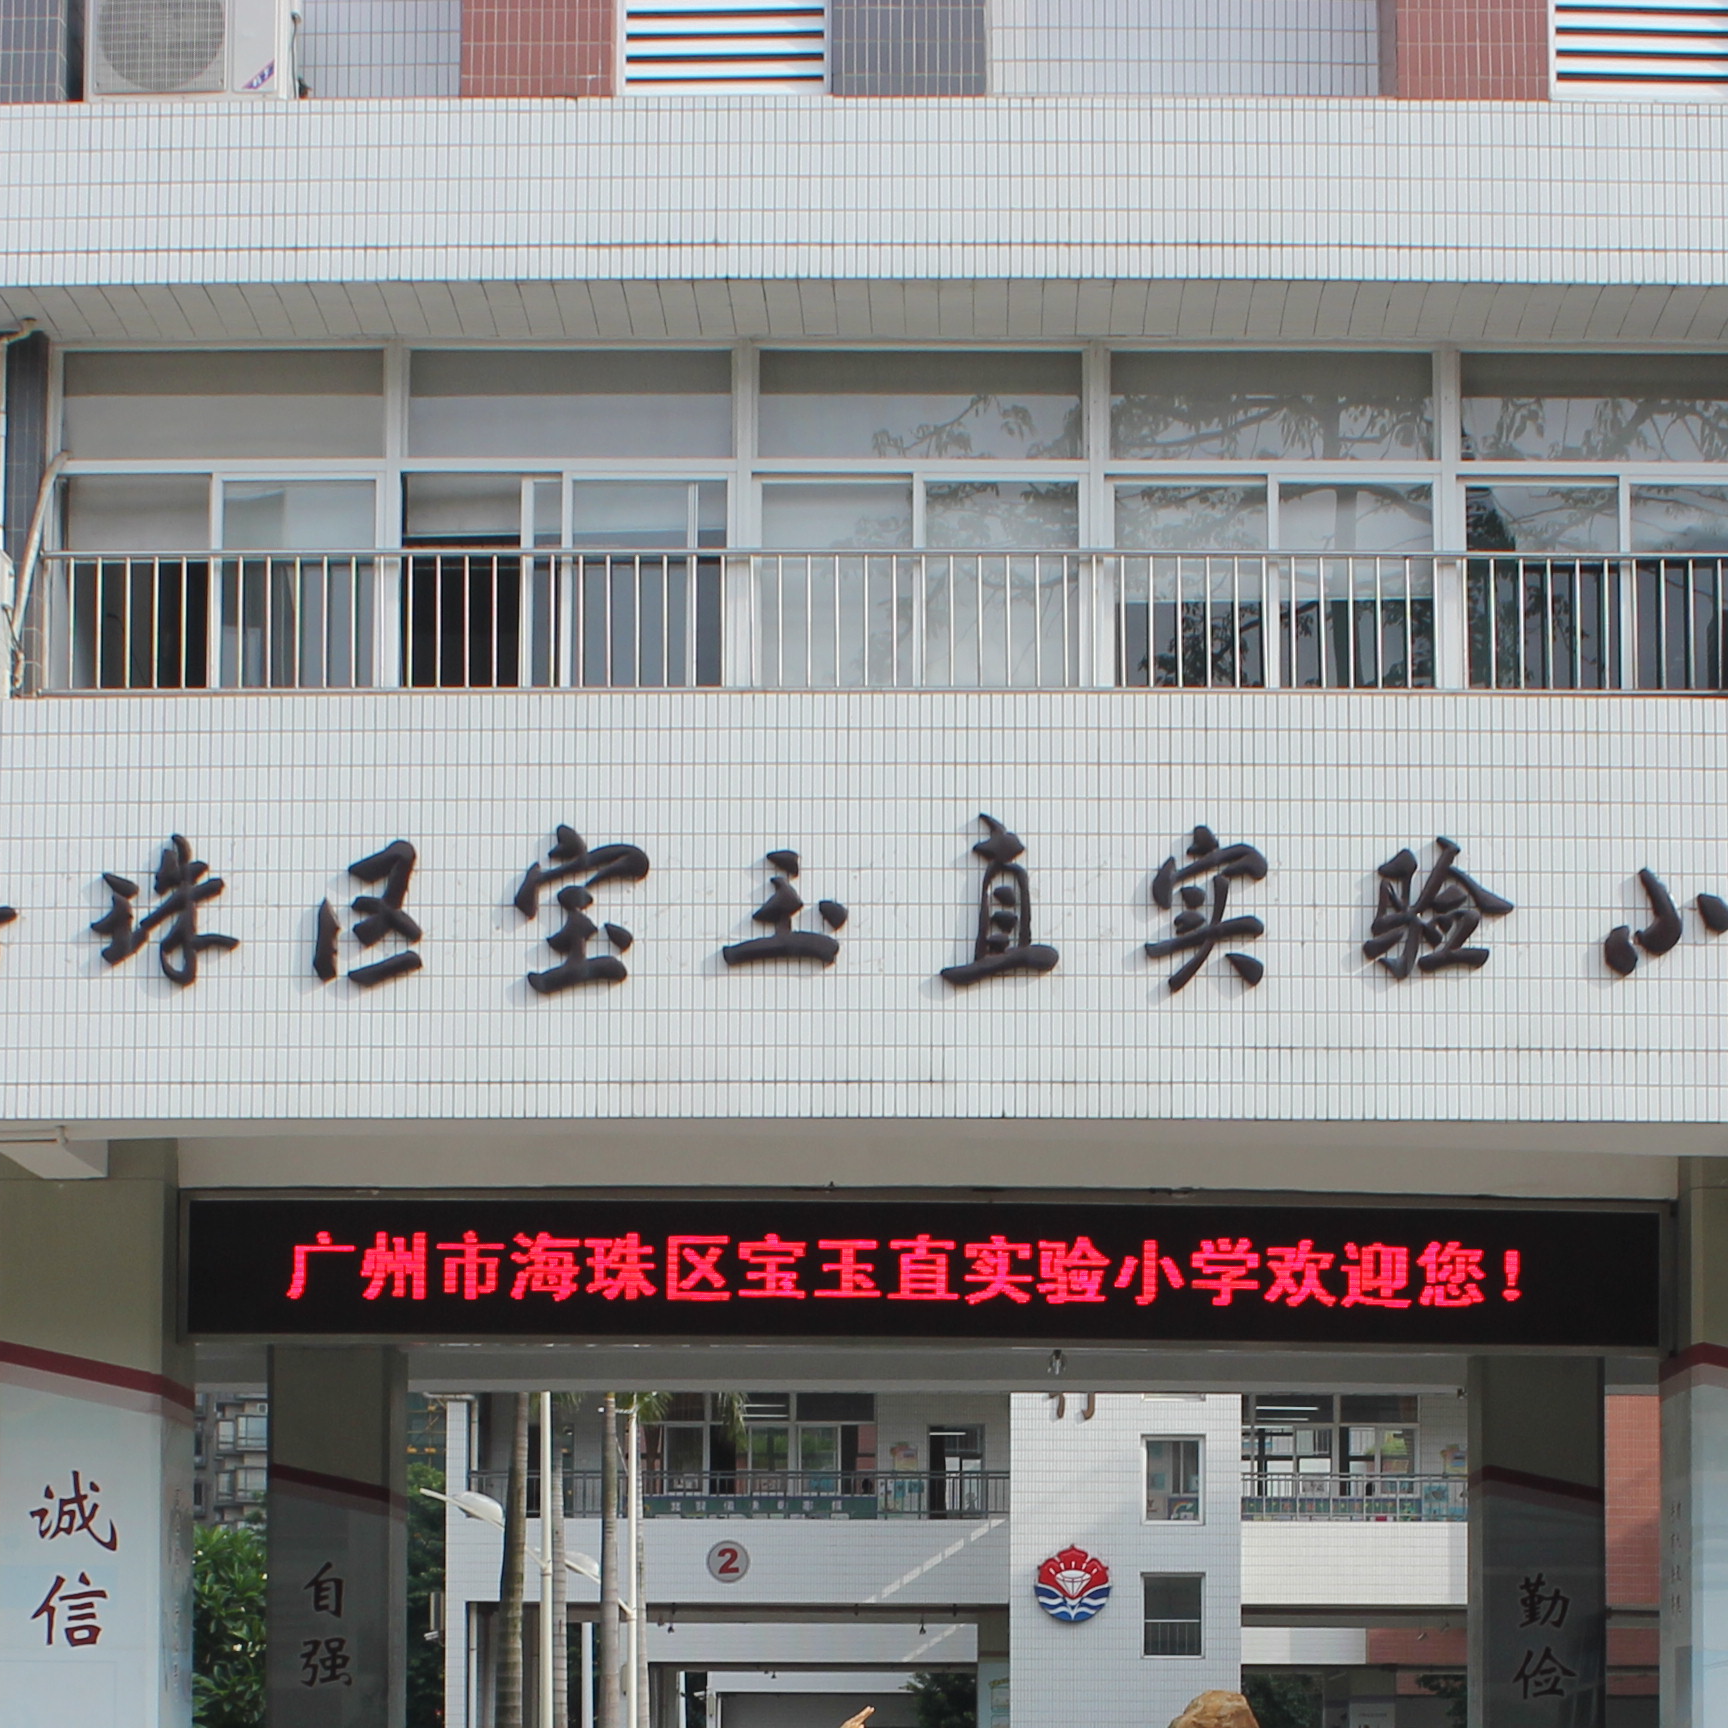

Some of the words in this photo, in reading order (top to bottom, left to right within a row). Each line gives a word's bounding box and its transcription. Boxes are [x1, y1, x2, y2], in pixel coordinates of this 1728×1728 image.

[29, 1470, 118, 1648] 诚信
[717, 1547, 740, 1575] 2
[299, 1561, 353, 1687] 自强
[1512, 1572, 1577, 1699] 勤俭
